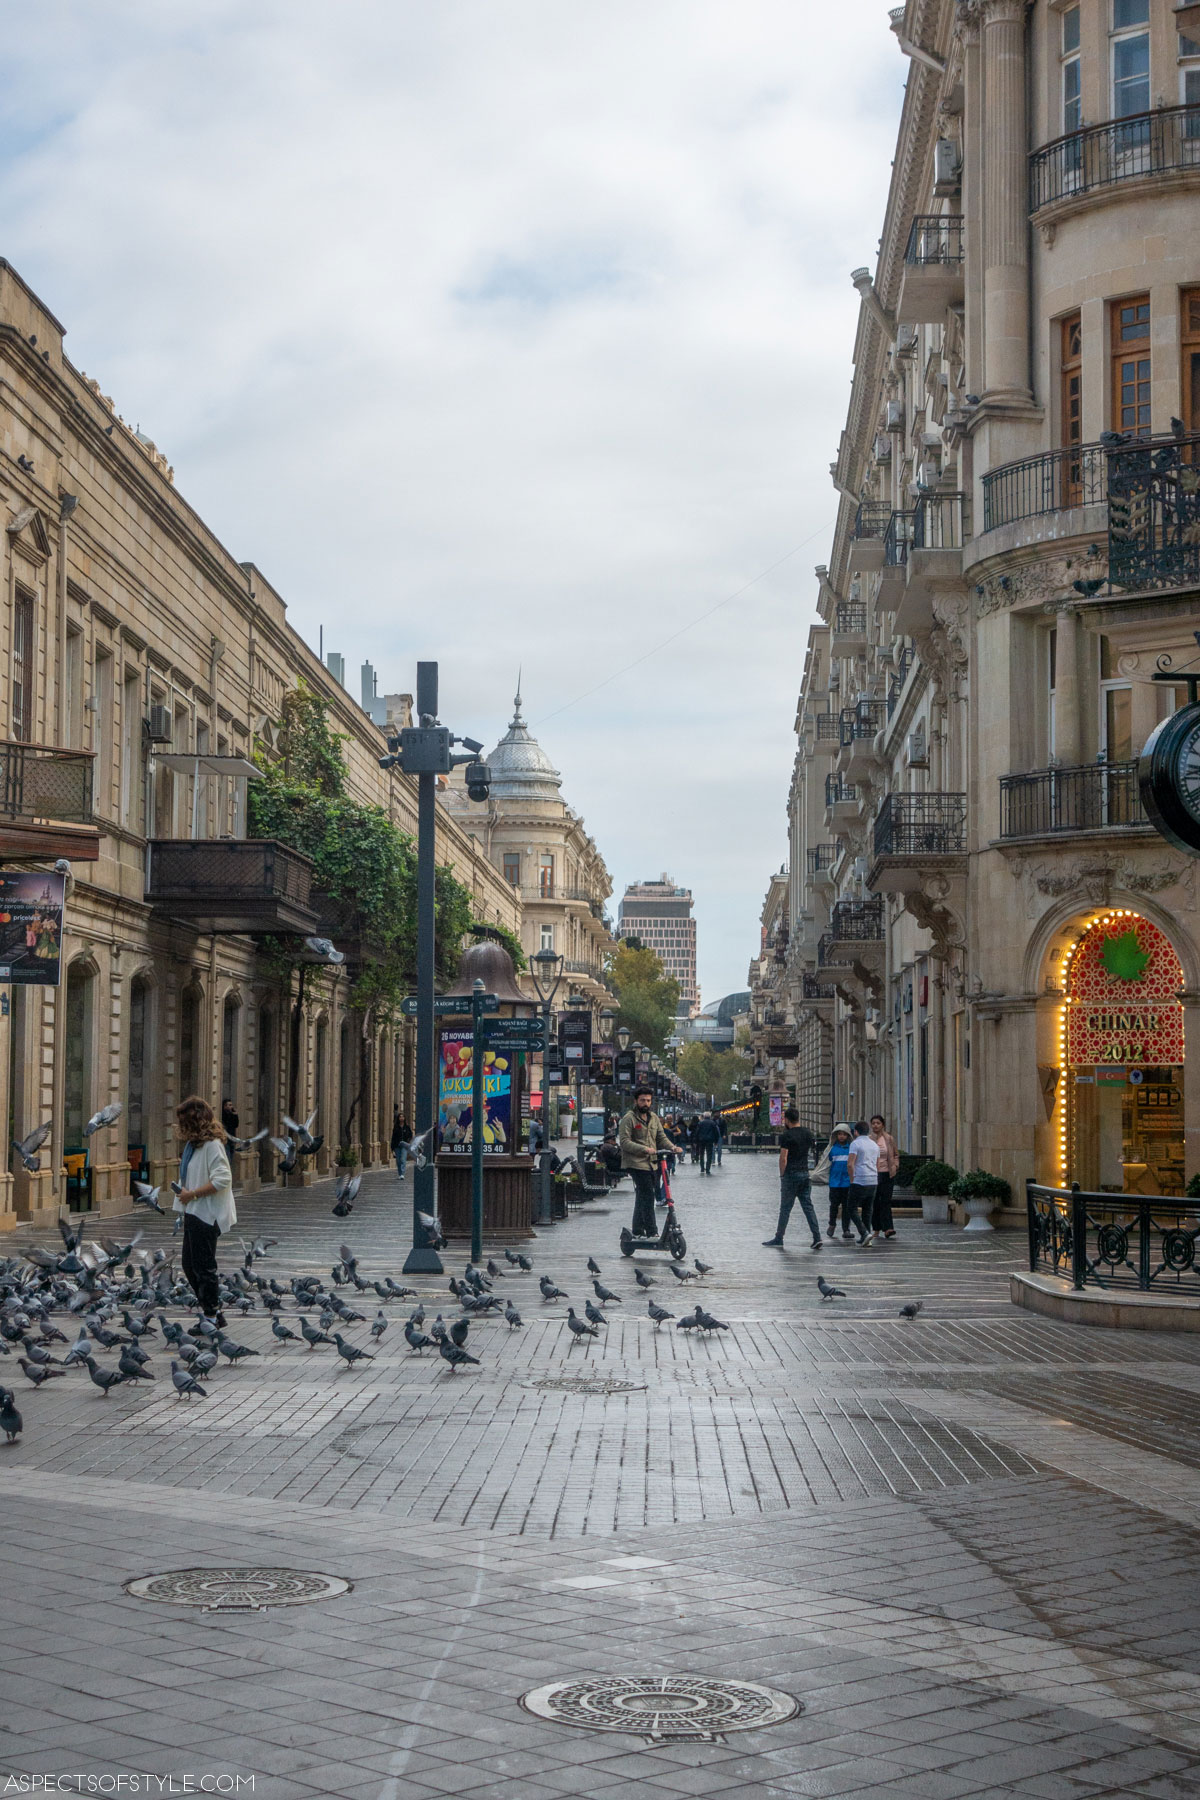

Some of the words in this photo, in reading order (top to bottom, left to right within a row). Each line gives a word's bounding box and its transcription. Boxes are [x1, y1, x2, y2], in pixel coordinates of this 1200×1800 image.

[1087, 1014, 1159, 1030] CHINAR
[441, 1032, 448, 1041] 26
[1102, 1044, 1143, 1060] 2012
[443, 1077, 501, 1092] KUKUIKI
[454, 1145, 465, 1153] 051
[483, 1145, 492, 1153] 35
[494, 1145, 503, 1153] 40
